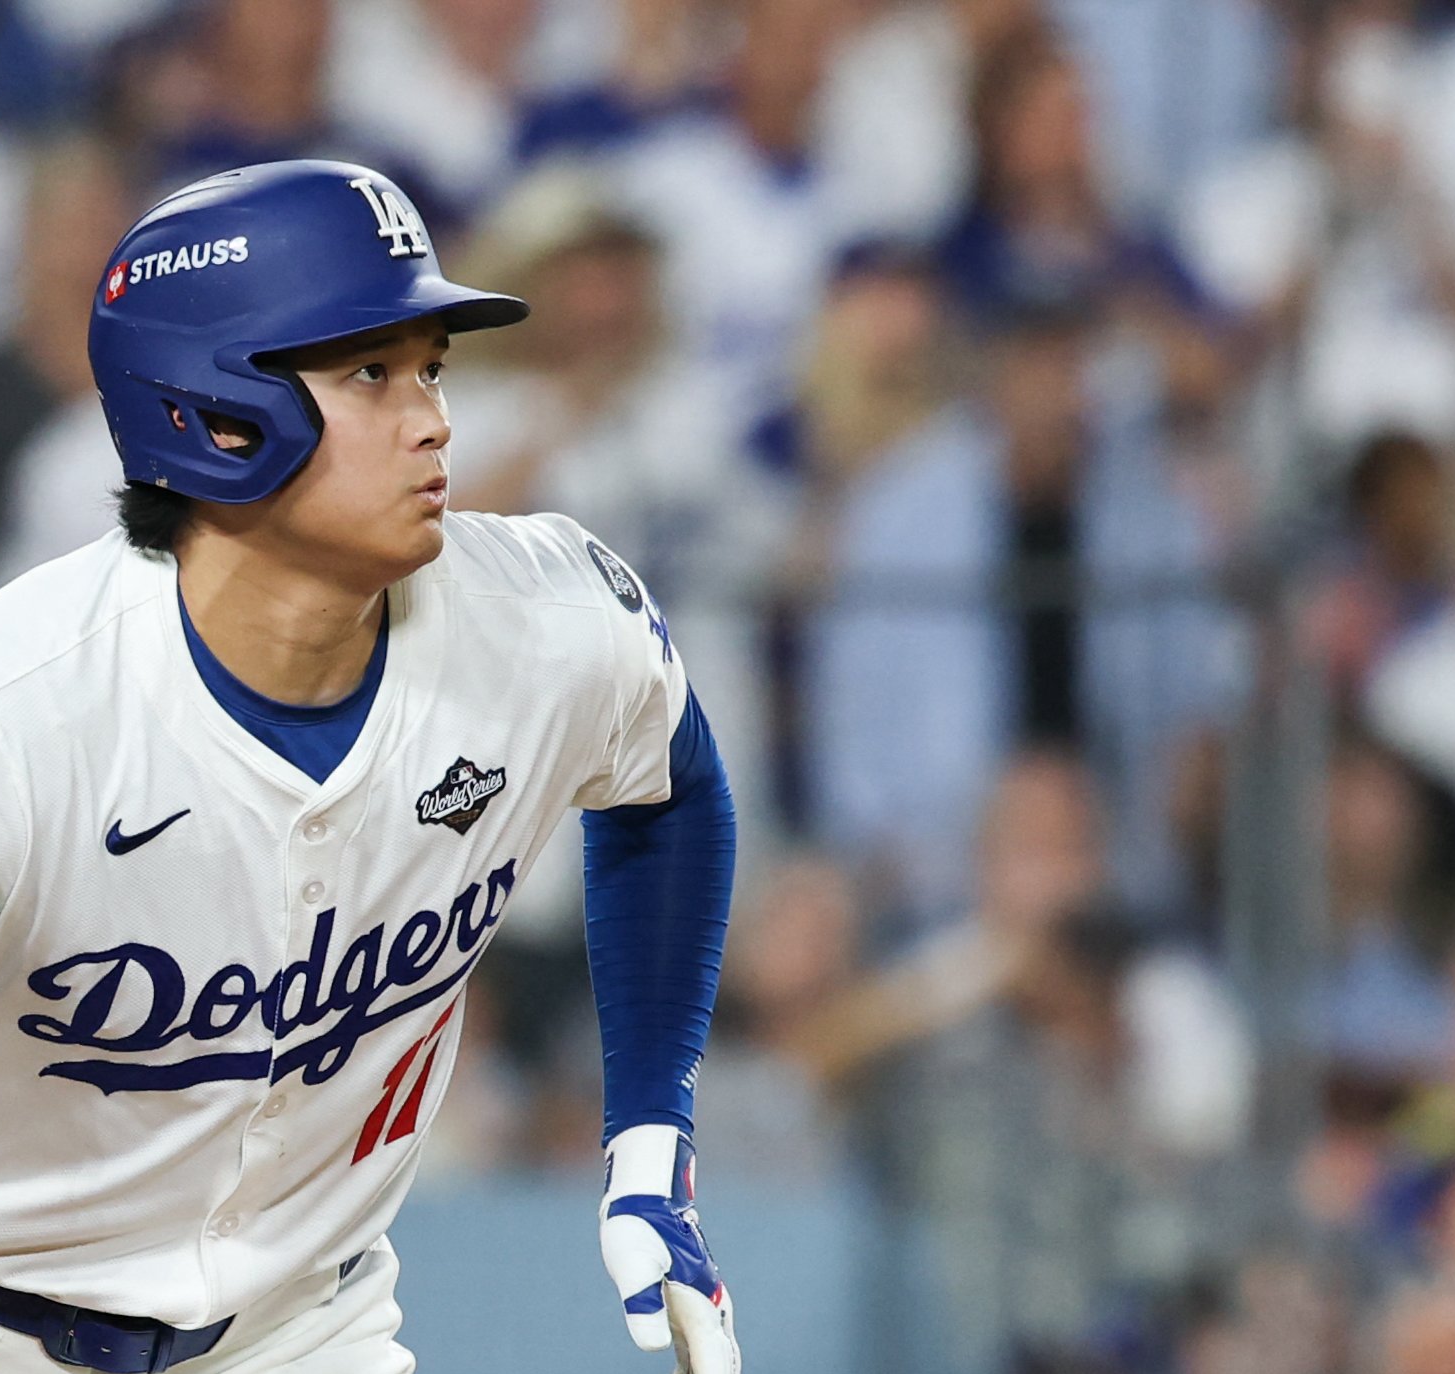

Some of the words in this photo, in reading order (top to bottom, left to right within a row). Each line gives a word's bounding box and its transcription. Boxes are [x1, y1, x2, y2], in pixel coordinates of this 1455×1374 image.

[349, 177, 427, 258] LA
[129, 236, 249, 285] STRAUSS
[420, 783, 469, 820] World
[461, 773, 503, 811] Series
[18, 858, 517, 1096] Dodgers
[350, 996, 457, 1167] 11
